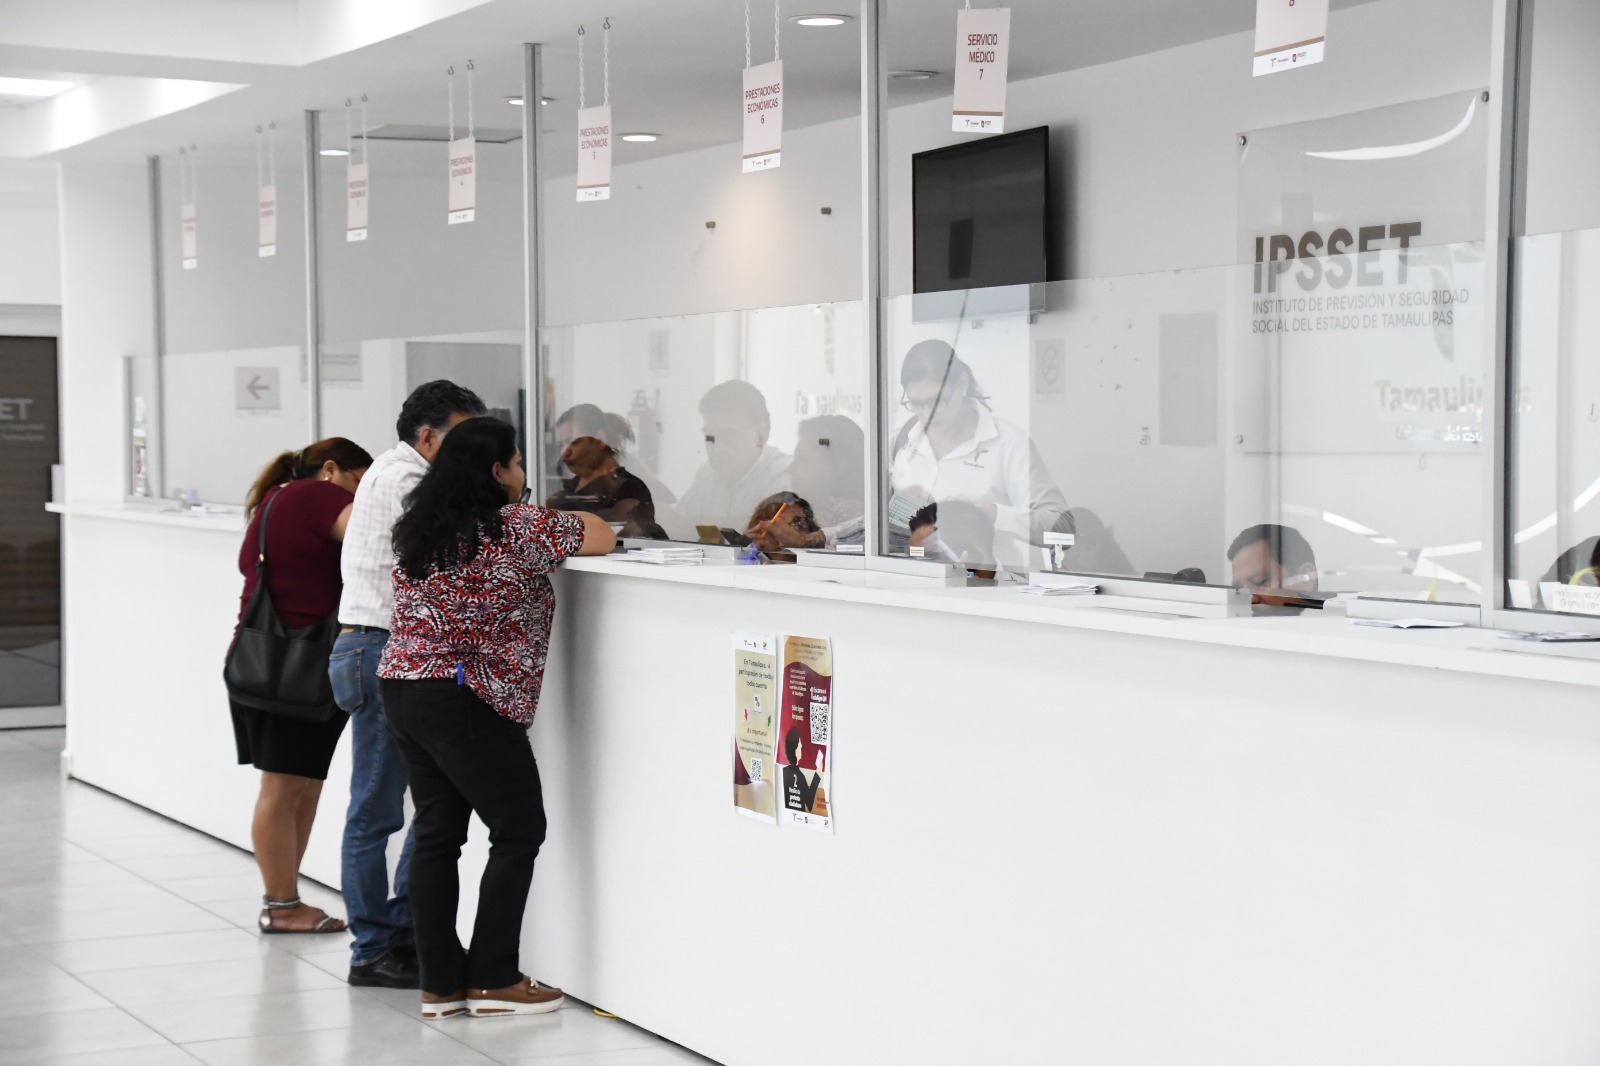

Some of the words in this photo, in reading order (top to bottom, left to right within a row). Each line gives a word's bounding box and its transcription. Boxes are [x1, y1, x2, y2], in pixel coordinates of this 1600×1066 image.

[967, 33, 998, 46] SERVICIO
[968, 47, 995, 63] MÉDICO
[979, 68, 984, 80] 7
[745, 83, 781, 100] PRESTACIONES
[760, 114, 765, 124] 6
[1253, 221, 1422, 294] IPSSET
[1252, 298, 1306, 315] INSTITUTO
[1308, 297, 1324, 312] DE
[1326, 290, 1385, 311] PREVISIÓN
[1387, 293, 1396, 307] Y
[1398, 288, 1470, 307] SEGURIDAD
[1252, 318, 1290, 334] SOCIAL
[1292, 317, 1314, 332] DEL
[1316, 314, 1360, 331] ESTADO
[1362, 313, 1378, 329] DE
[1383, 310, 1454, 327] TAMAULIPAS
